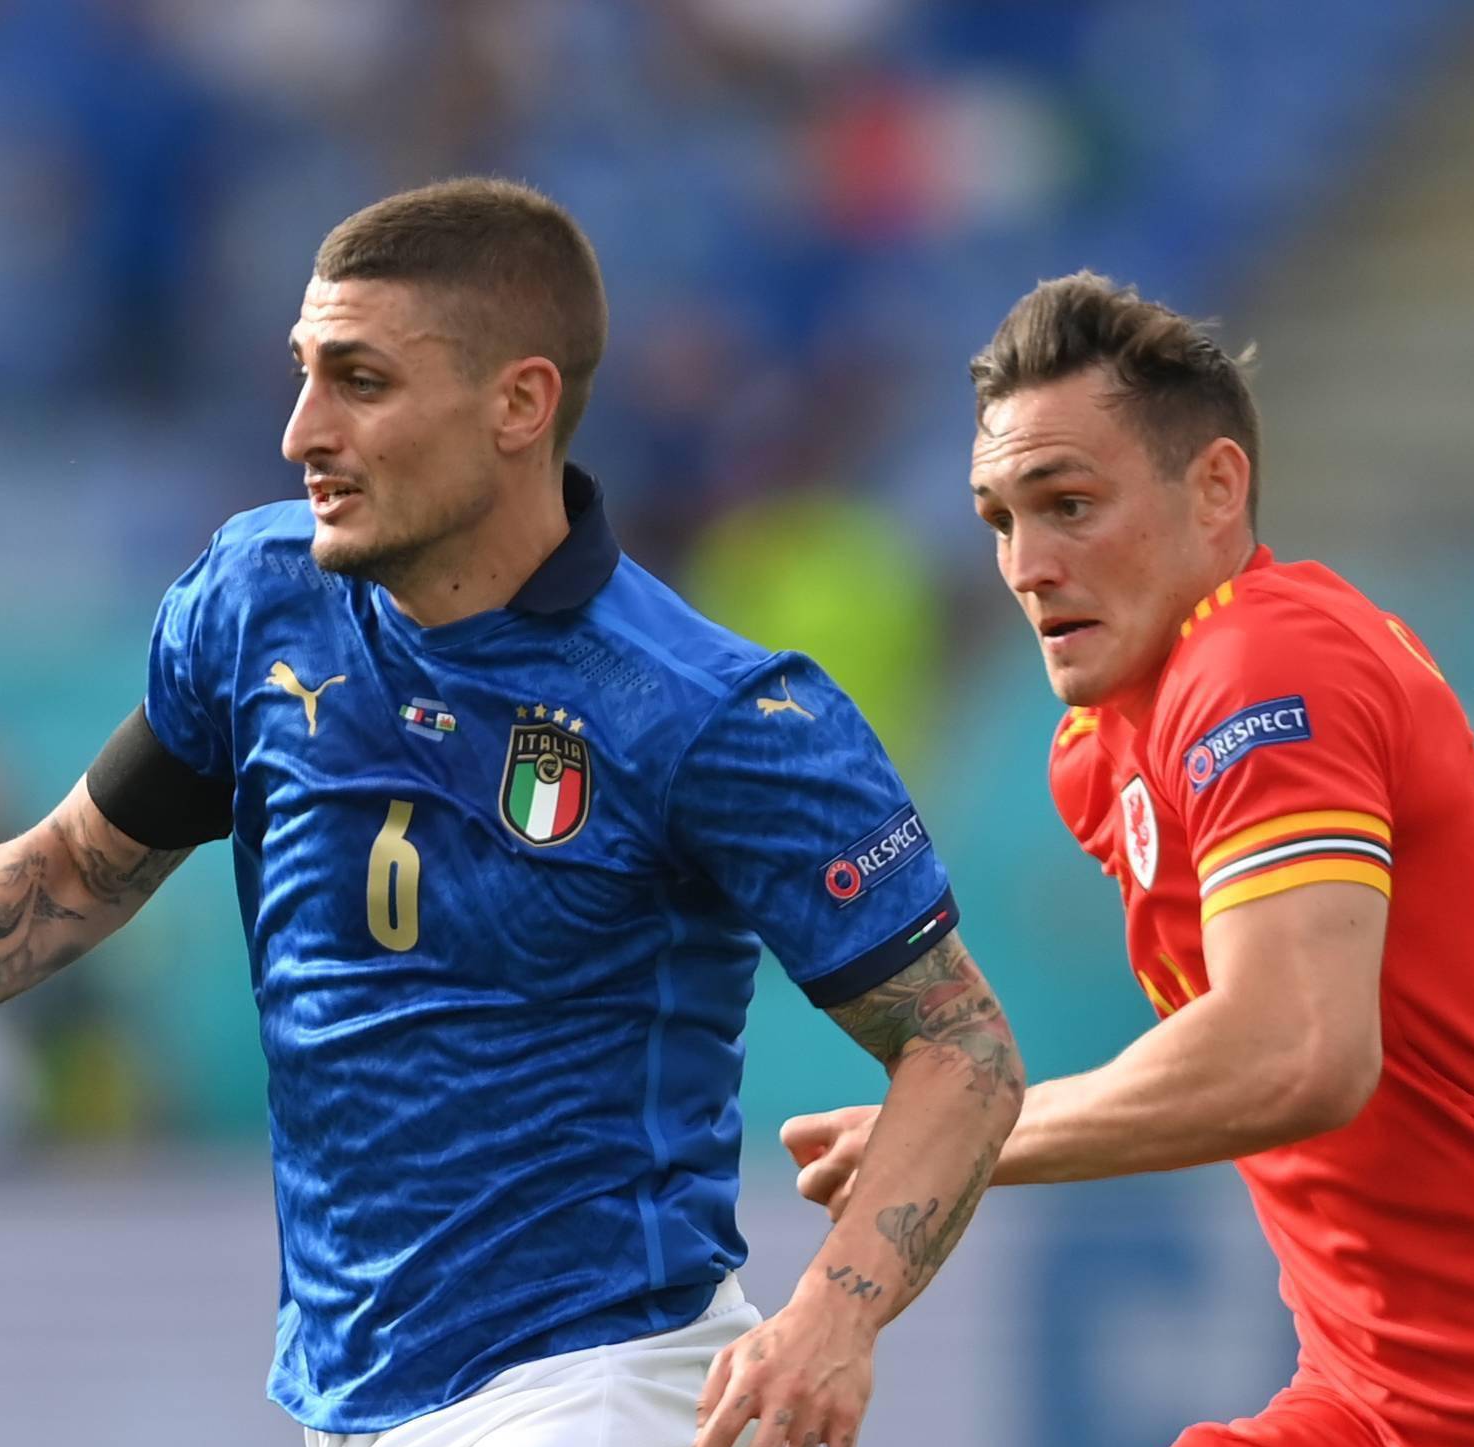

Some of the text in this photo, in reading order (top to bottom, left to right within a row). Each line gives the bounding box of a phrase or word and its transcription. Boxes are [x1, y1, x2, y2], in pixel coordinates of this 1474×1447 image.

[518, 733, 582, 760] ITALIA
[1212, 707, 1304, 759] RESPECT
[857, 814, 923, 876] RESPECT
[367, 799, 420, 952] 6
